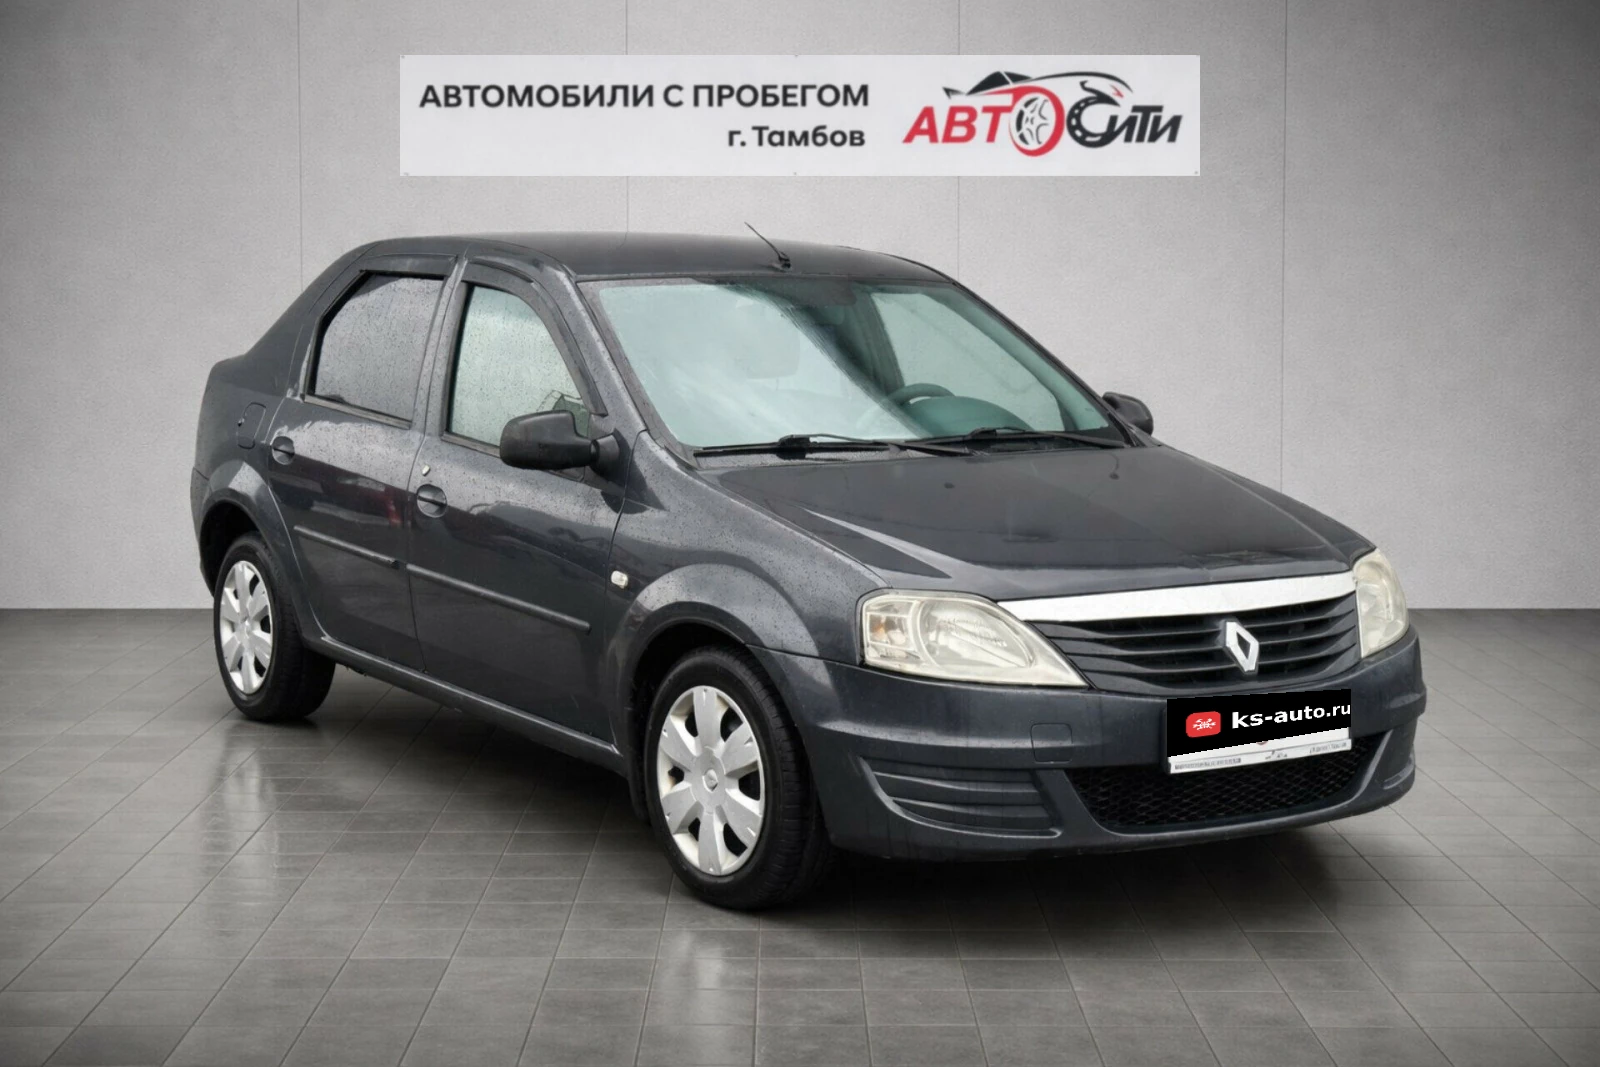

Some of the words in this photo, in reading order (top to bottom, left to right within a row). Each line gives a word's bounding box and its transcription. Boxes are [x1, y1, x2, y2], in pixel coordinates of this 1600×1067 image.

[419, 84, 654, 108] АВТОМОБИЛИ
[663, 84, 684, 108] С
[694, 83, 869, 108] ПРОБЕГОМ
[728, 130, 747, 147] г.
[752, 125, 866, 148] Тамбов
